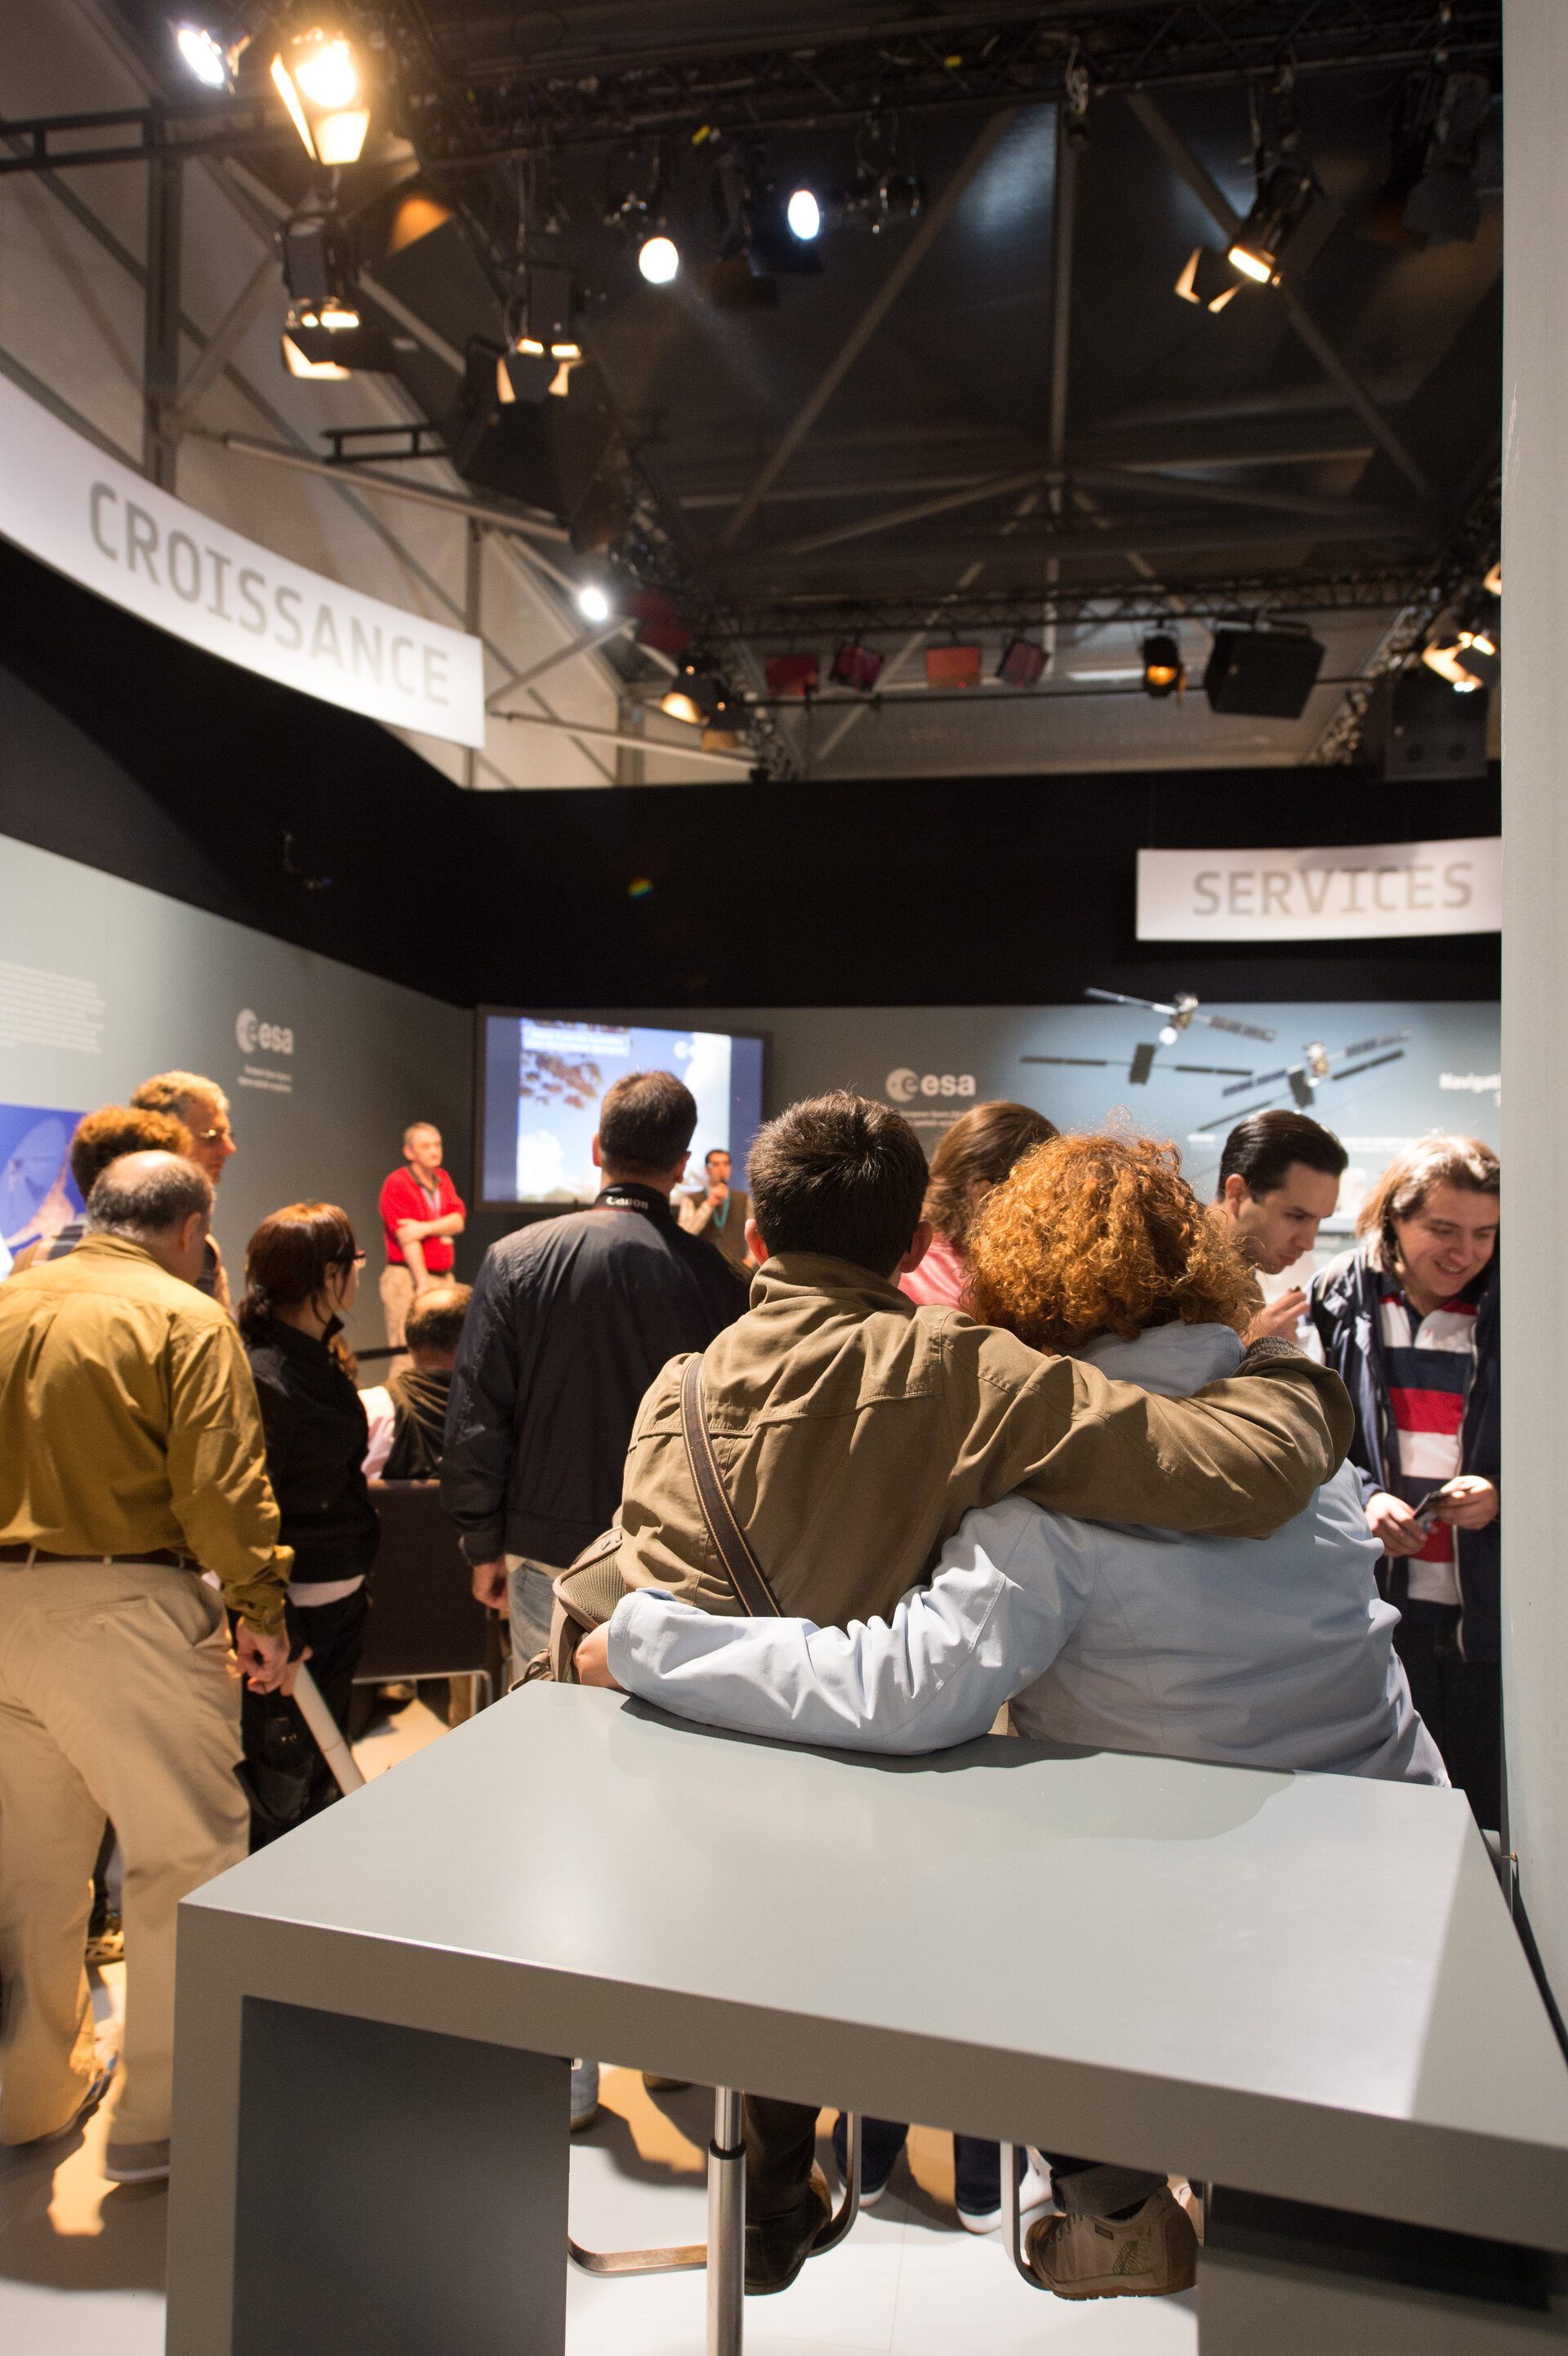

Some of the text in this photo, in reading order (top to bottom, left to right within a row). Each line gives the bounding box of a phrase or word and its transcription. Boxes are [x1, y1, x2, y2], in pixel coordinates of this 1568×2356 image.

[89, 480, 450, 707] CROISSANCE
[1192, 862, 1474, 916] SERVICES
[259, 1022, 294, 1054] esa
[920, 1073, 976, 1097] esa
[606, 1196, 649, 1209] Canon
